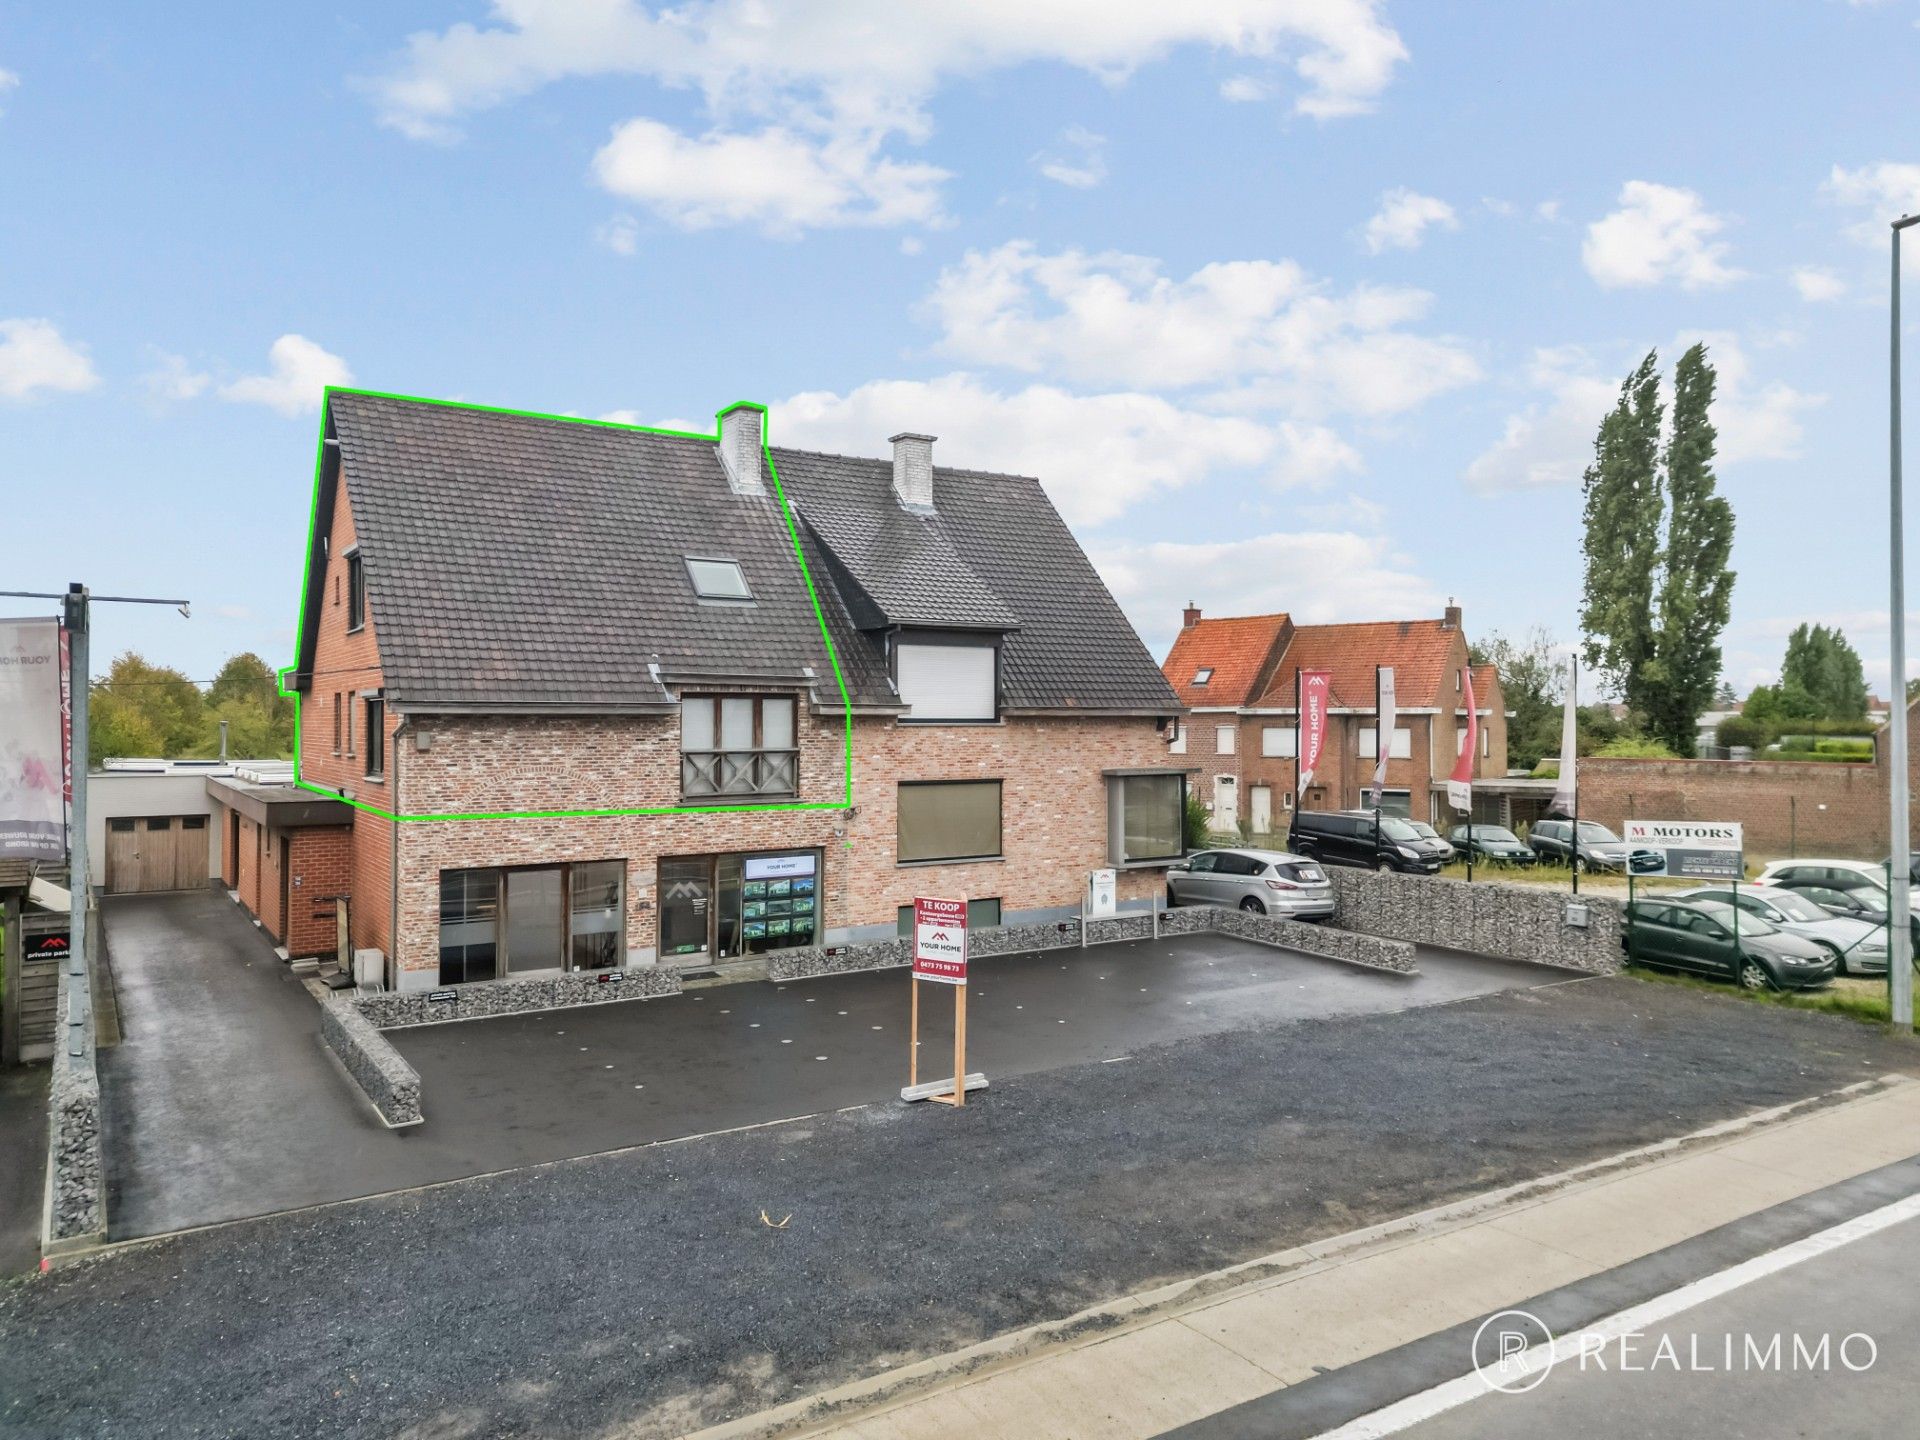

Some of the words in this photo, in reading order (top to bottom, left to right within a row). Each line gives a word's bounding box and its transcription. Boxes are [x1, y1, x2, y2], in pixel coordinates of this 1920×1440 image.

[1310, 695, 1318, 730] HOME
[1309, 734, 1318, 765] YOUR
[1632, 826, 1646, 836] M
[1653, 827, 1734, 838] MOTORS
[922, 900, 933, 909] TE
[934, 903, 960, 912] KOOP
